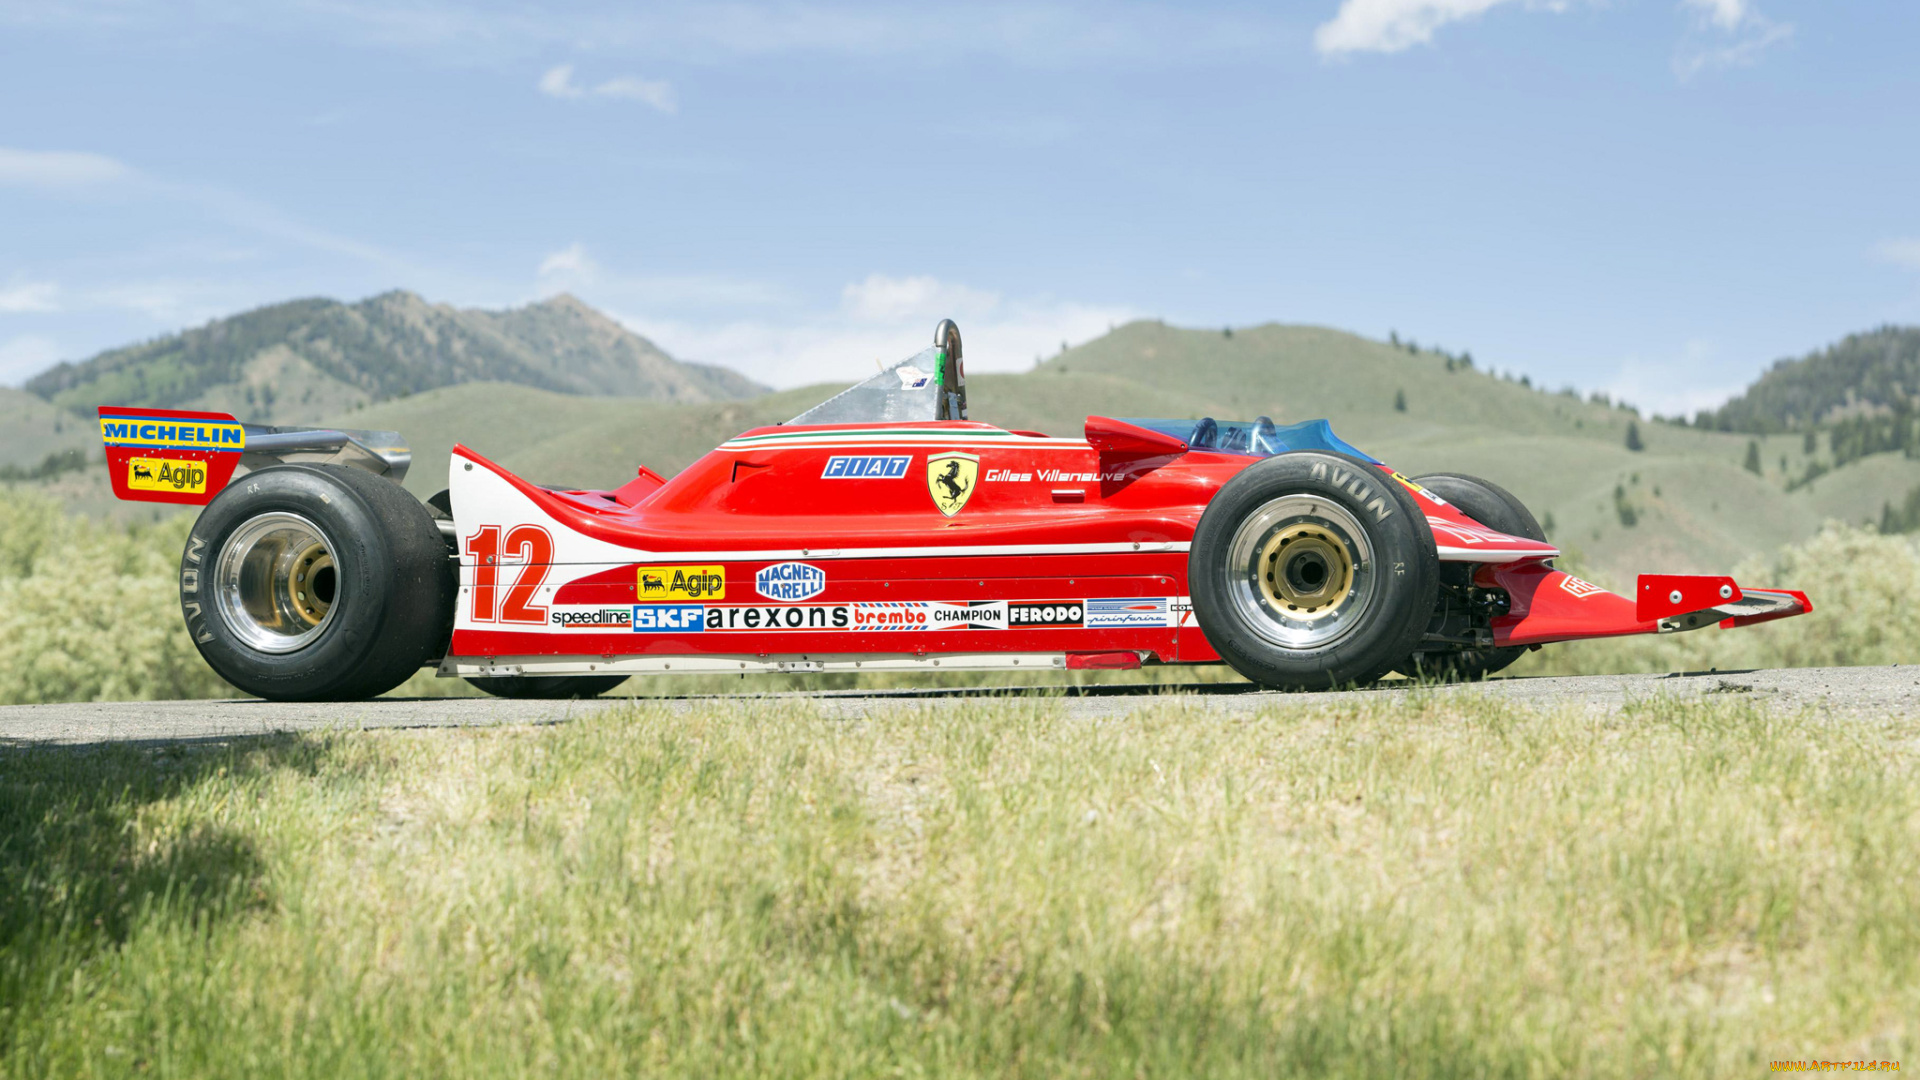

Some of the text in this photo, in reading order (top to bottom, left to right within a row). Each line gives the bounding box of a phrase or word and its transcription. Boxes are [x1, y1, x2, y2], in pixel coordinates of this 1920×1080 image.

[105, 423, 241, 444] MICHELIN
[157, 462, 204, 489] Agip
[829, 460, 905, 474] FIAT
[985, 469, 1126, 482] Gilles Villeneuve
[1308, 462, 1393, 524] AVON
[466, 524, 554, 626] 12
[758, 564, 823, 582] MAGNETI
[670, 570, 722, 598] Agip
[758, 581, 823, 599] MARELLI
[552, 609, 630, 628] speedline
[635, 608, 703, 629] SKF
[706, 606, 848, 628] arexons
[854, 607, 926, 624] brembo
[934, 610, 1001, 622] CHAMPION
[1009, 607, 1082, 622] FERODO
[1087, 614, 1166, 624] pininfarina
